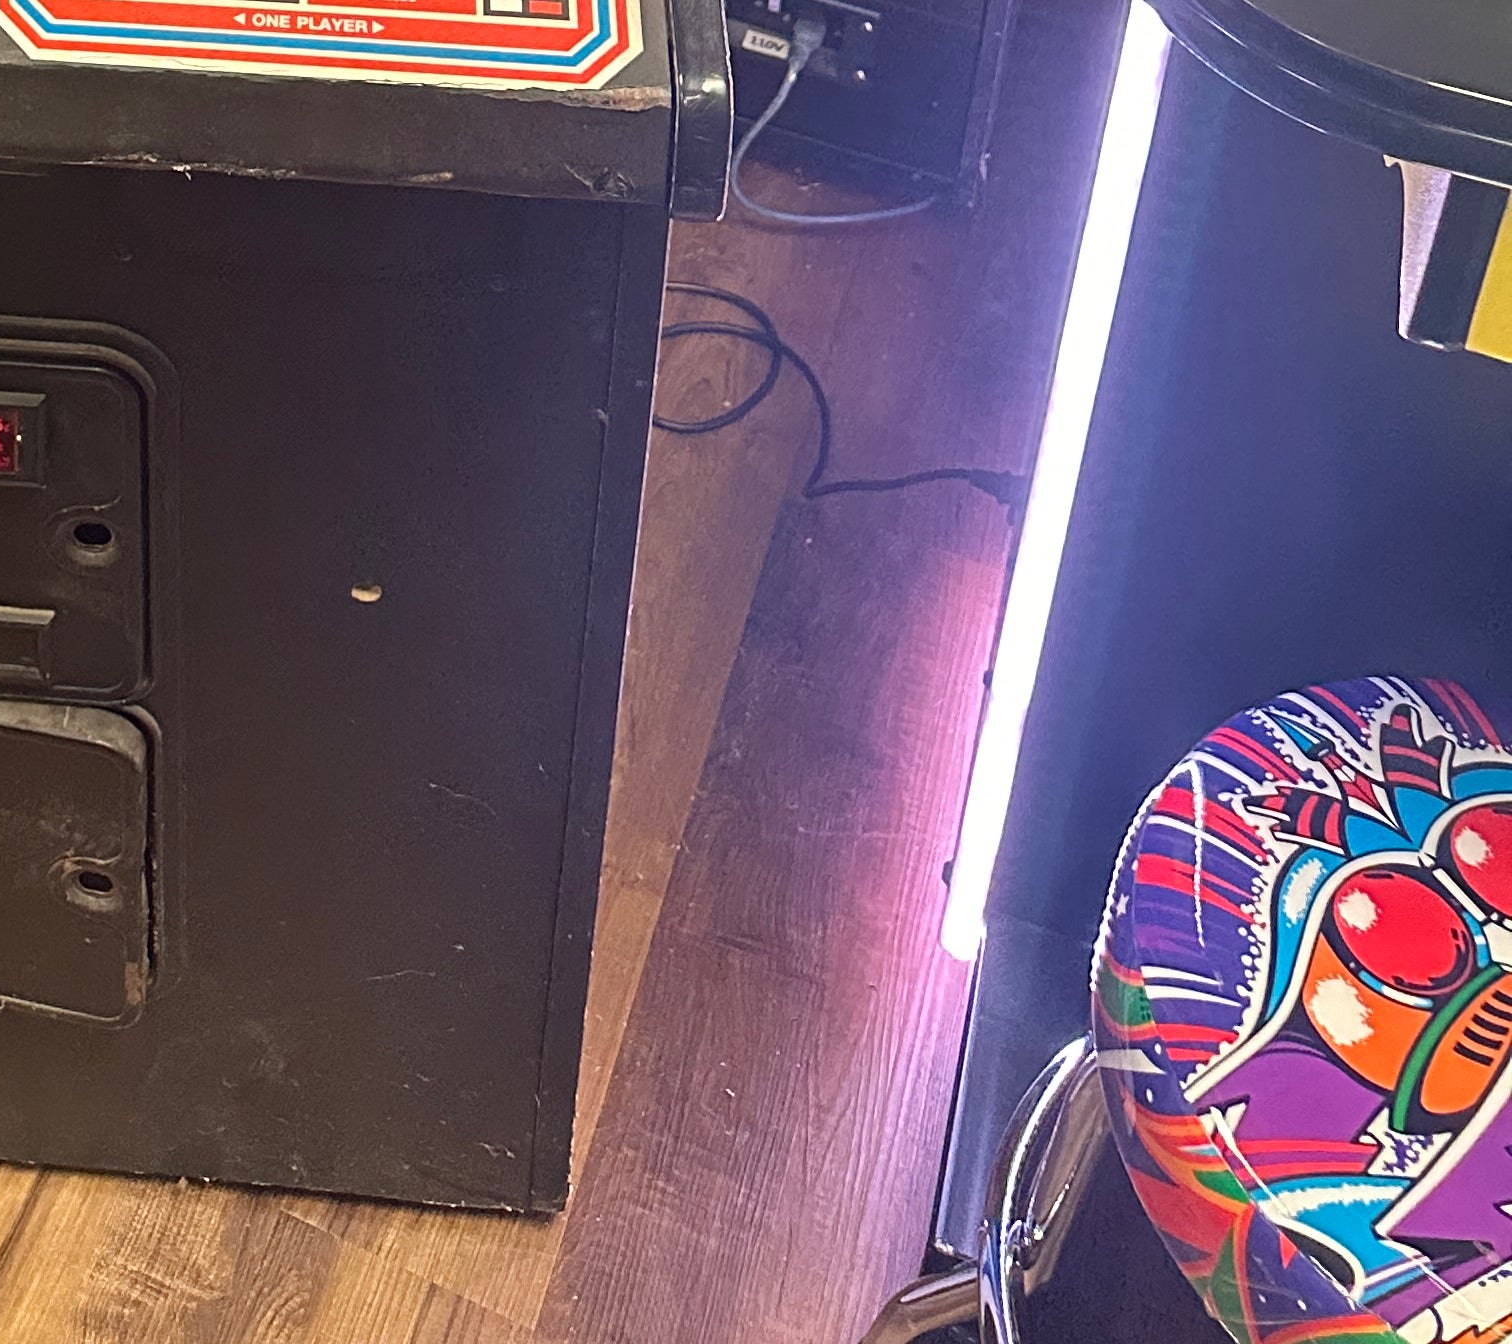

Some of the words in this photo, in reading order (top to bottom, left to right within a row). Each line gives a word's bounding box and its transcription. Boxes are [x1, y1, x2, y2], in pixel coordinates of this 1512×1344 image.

[252, 13, 289, 30] ONE
[294, 15, 369, 35] PLAYER
[749, 34, 785, 53] 110V
